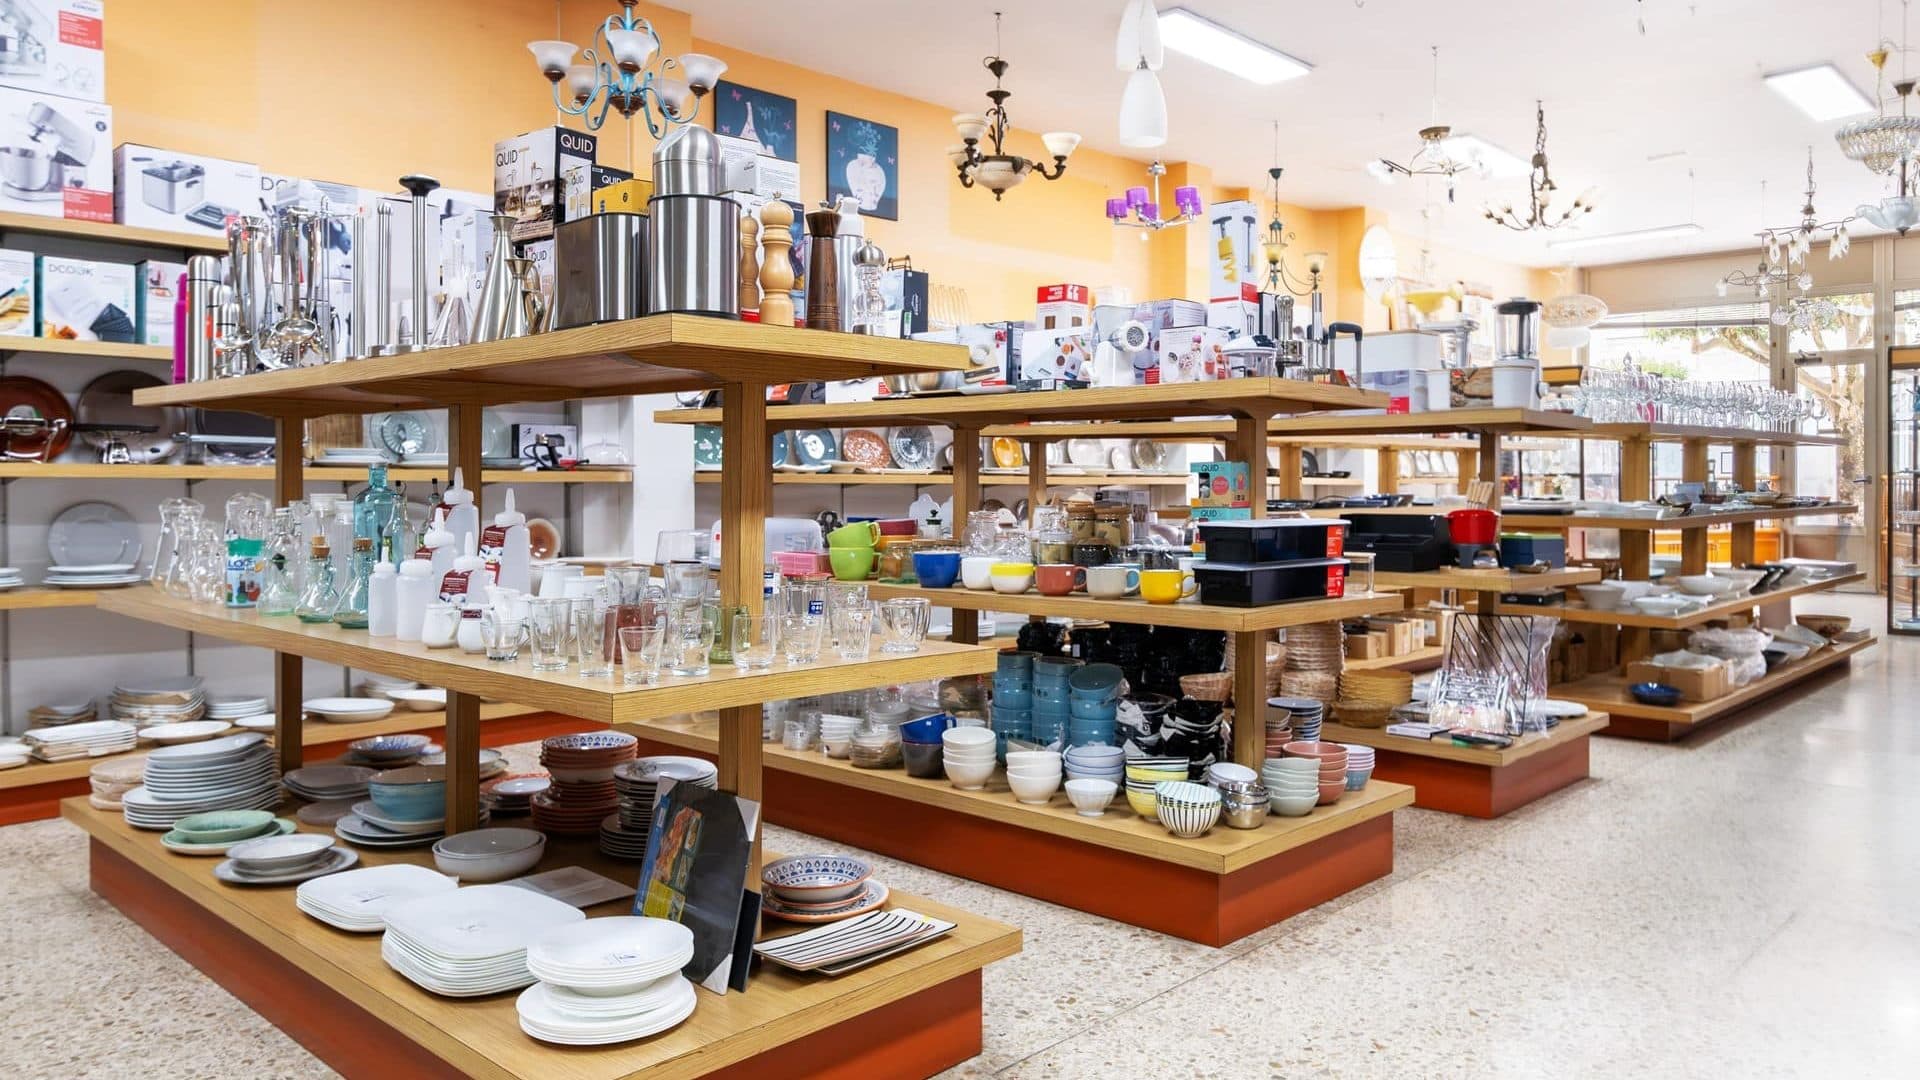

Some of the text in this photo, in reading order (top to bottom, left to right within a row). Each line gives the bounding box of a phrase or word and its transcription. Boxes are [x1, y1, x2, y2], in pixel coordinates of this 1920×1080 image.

[560, 133, 593, 153] QUID
[496, 149, 518, 168] QUID
[601, 174, 622, 185] QUID
[531, 250, 547, 262] QUID
[1200, 464, 1220, 472] QUID
[1200, 509, 1218, 518] QUID
